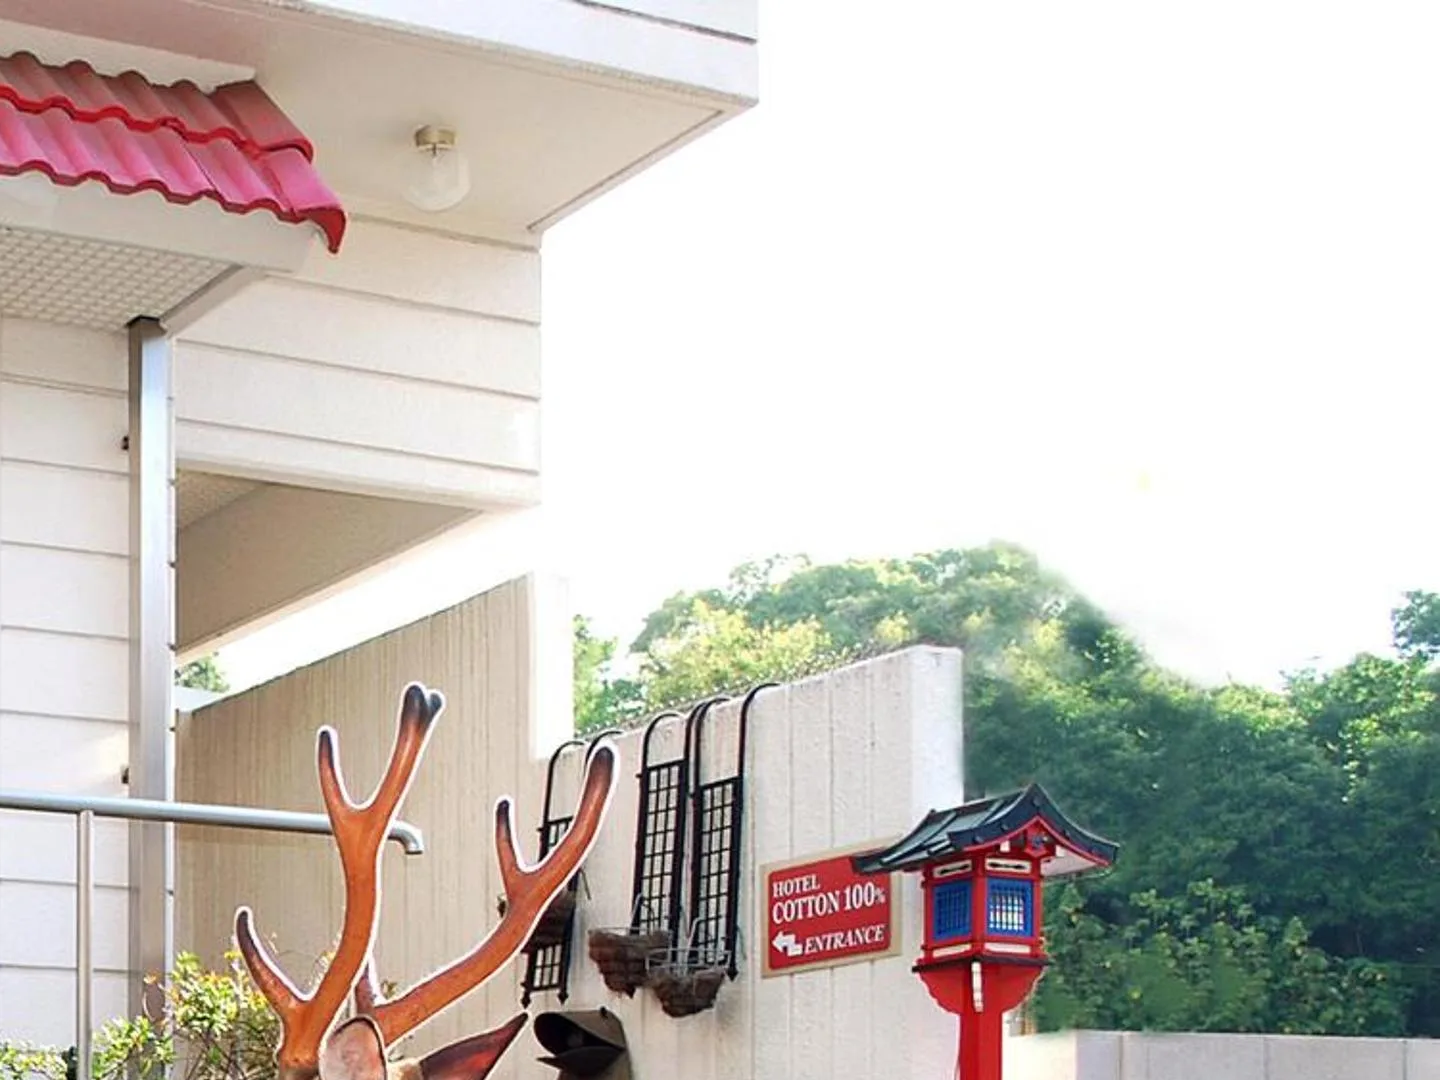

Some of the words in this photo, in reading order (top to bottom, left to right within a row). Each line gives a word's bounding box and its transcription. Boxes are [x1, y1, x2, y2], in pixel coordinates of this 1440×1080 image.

[773, 874, 820, 898] HOTEL
[772, 890, 840, 924] COTTON
[844, 881, 886, 911] 100%
[804, 924, 885, 955] ENTRANCE
